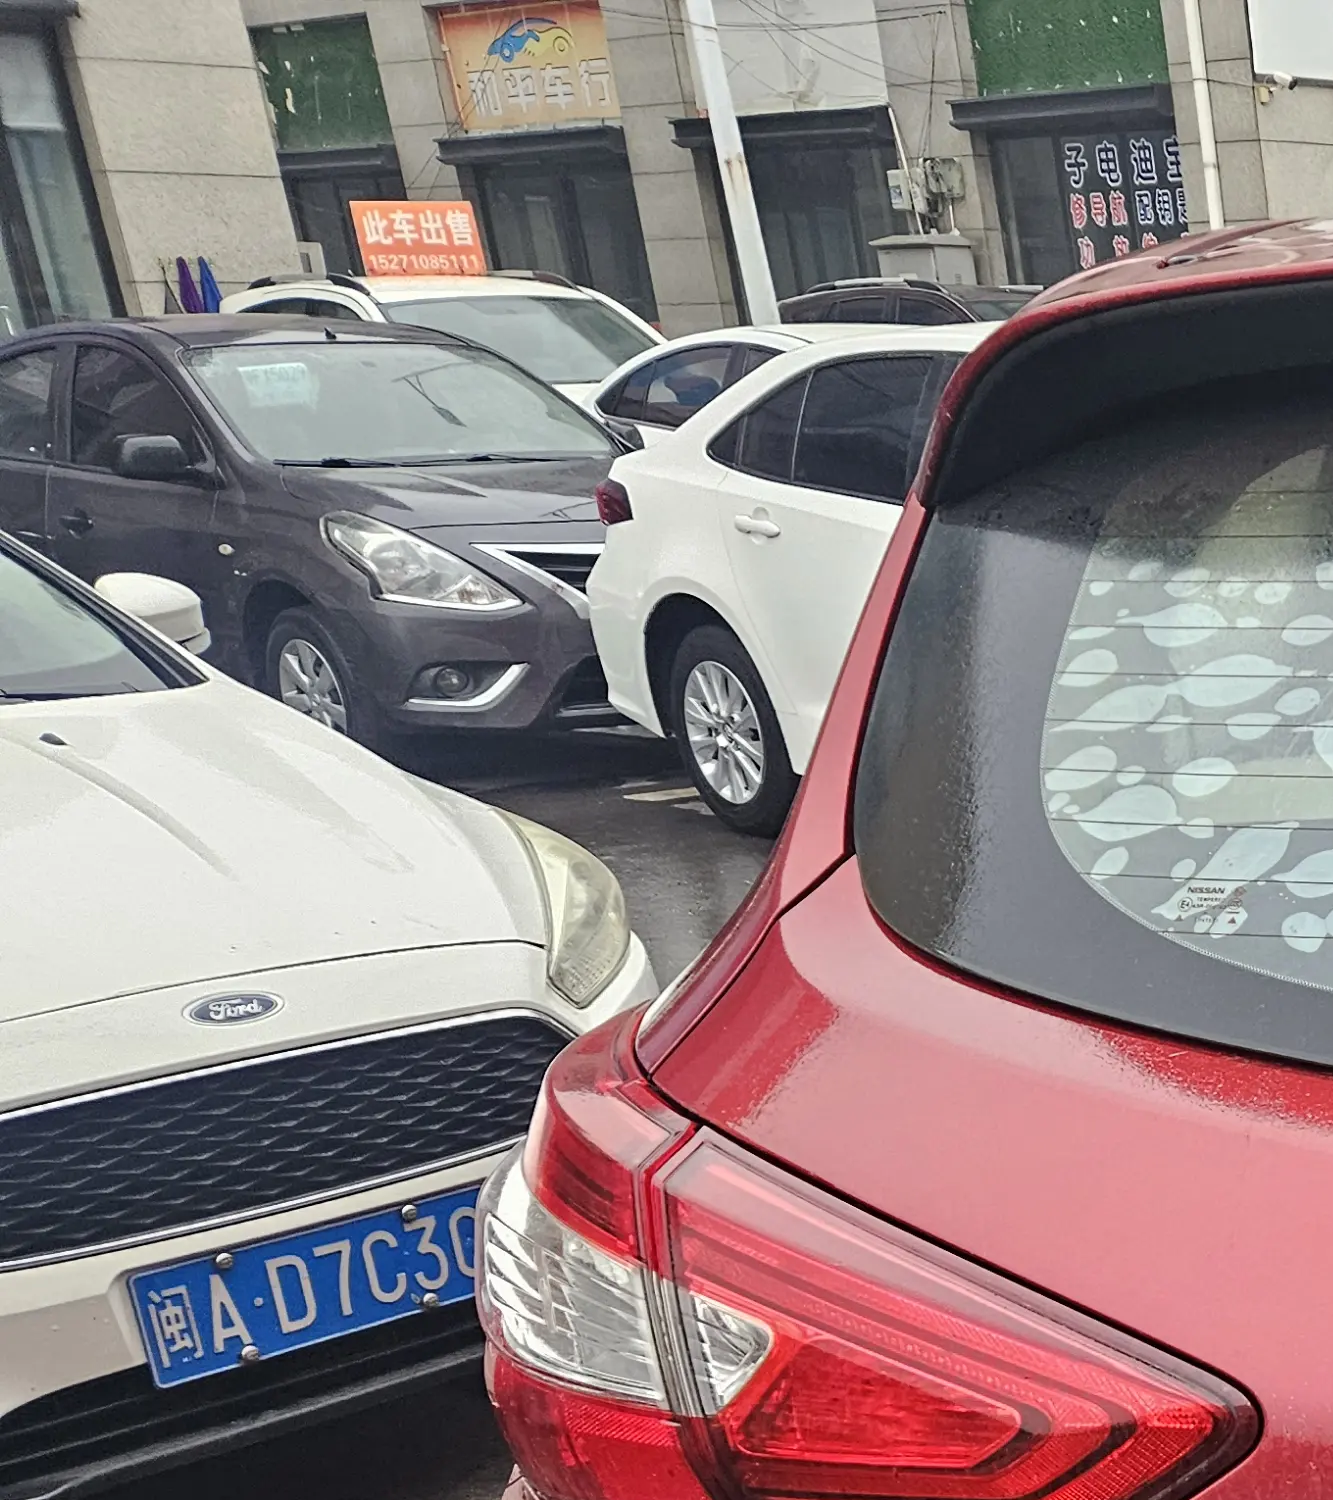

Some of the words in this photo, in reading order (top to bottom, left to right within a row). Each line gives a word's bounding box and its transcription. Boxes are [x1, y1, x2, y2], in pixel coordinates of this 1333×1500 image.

[467, 58, 611, 116] 和平车行
[362, 209, 474, 247] 此车出售
[368, 254, 480, 270] 15271085111
[1187, 886, 1225, 894] NISSAN
[208, 998, 263, 1020] Ford
